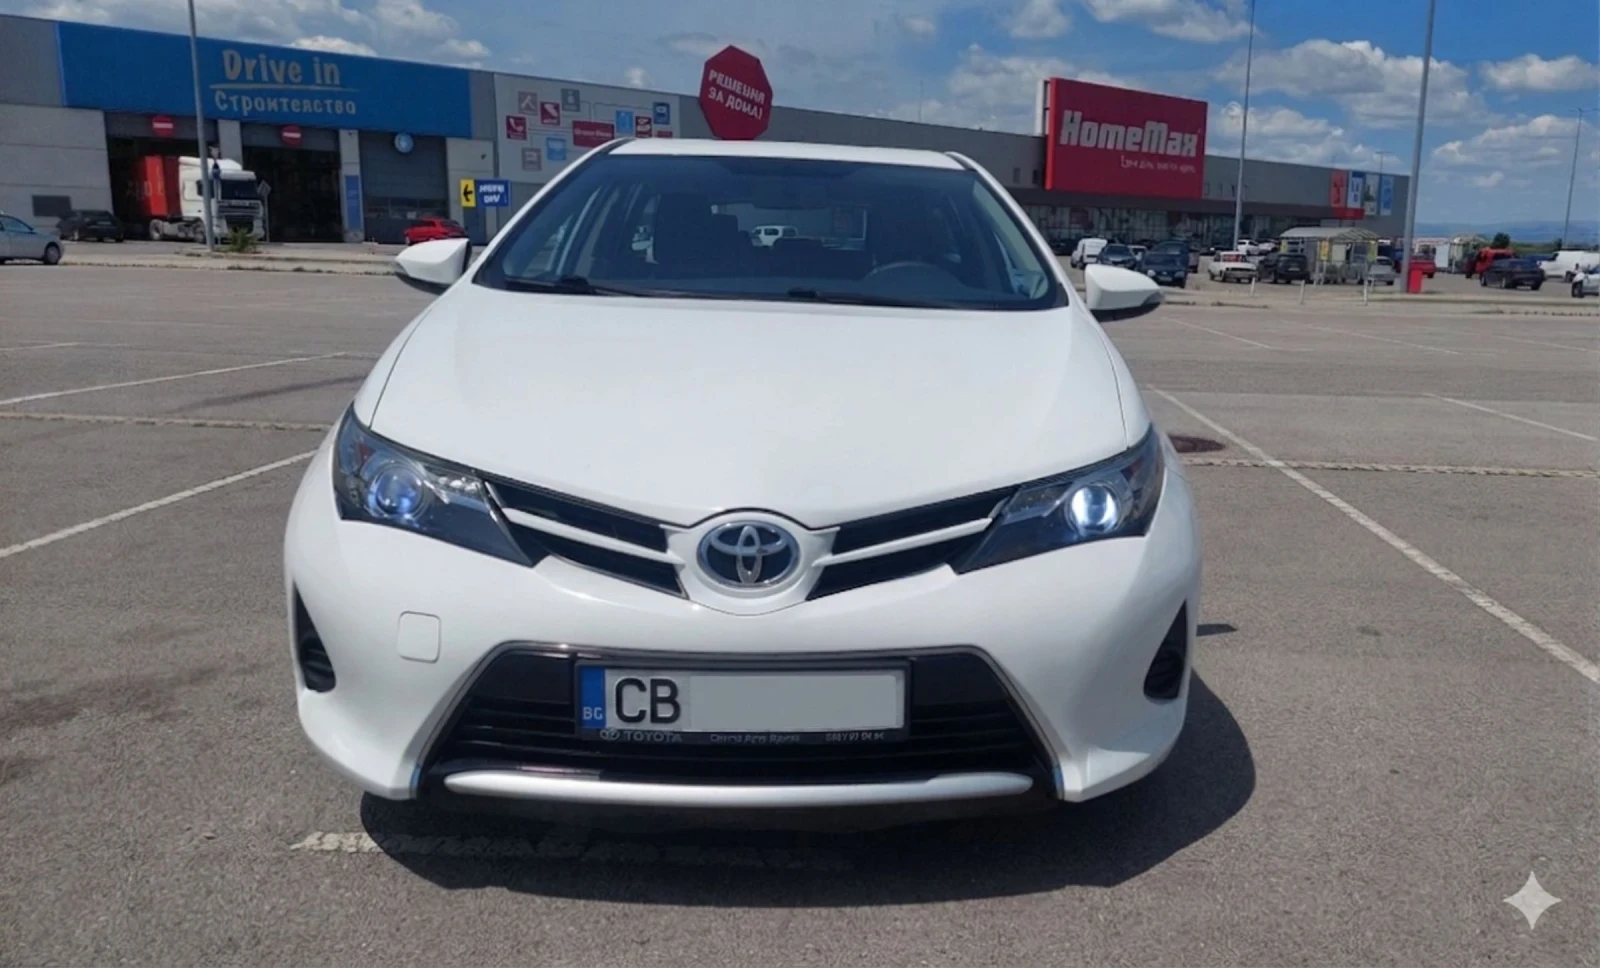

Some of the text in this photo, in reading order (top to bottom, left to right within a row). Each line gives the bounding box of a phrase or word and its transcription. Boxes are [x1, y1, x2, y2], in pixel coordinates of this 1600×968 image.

[222, 49, 341, 85] Drive in
[708, 87, 724, 103] ЗА
[1059, 109, 1199, 157] HomeMax
[582, 677, 681, 724] BG CB
[622, 729, 683, 742] TOYOTA
